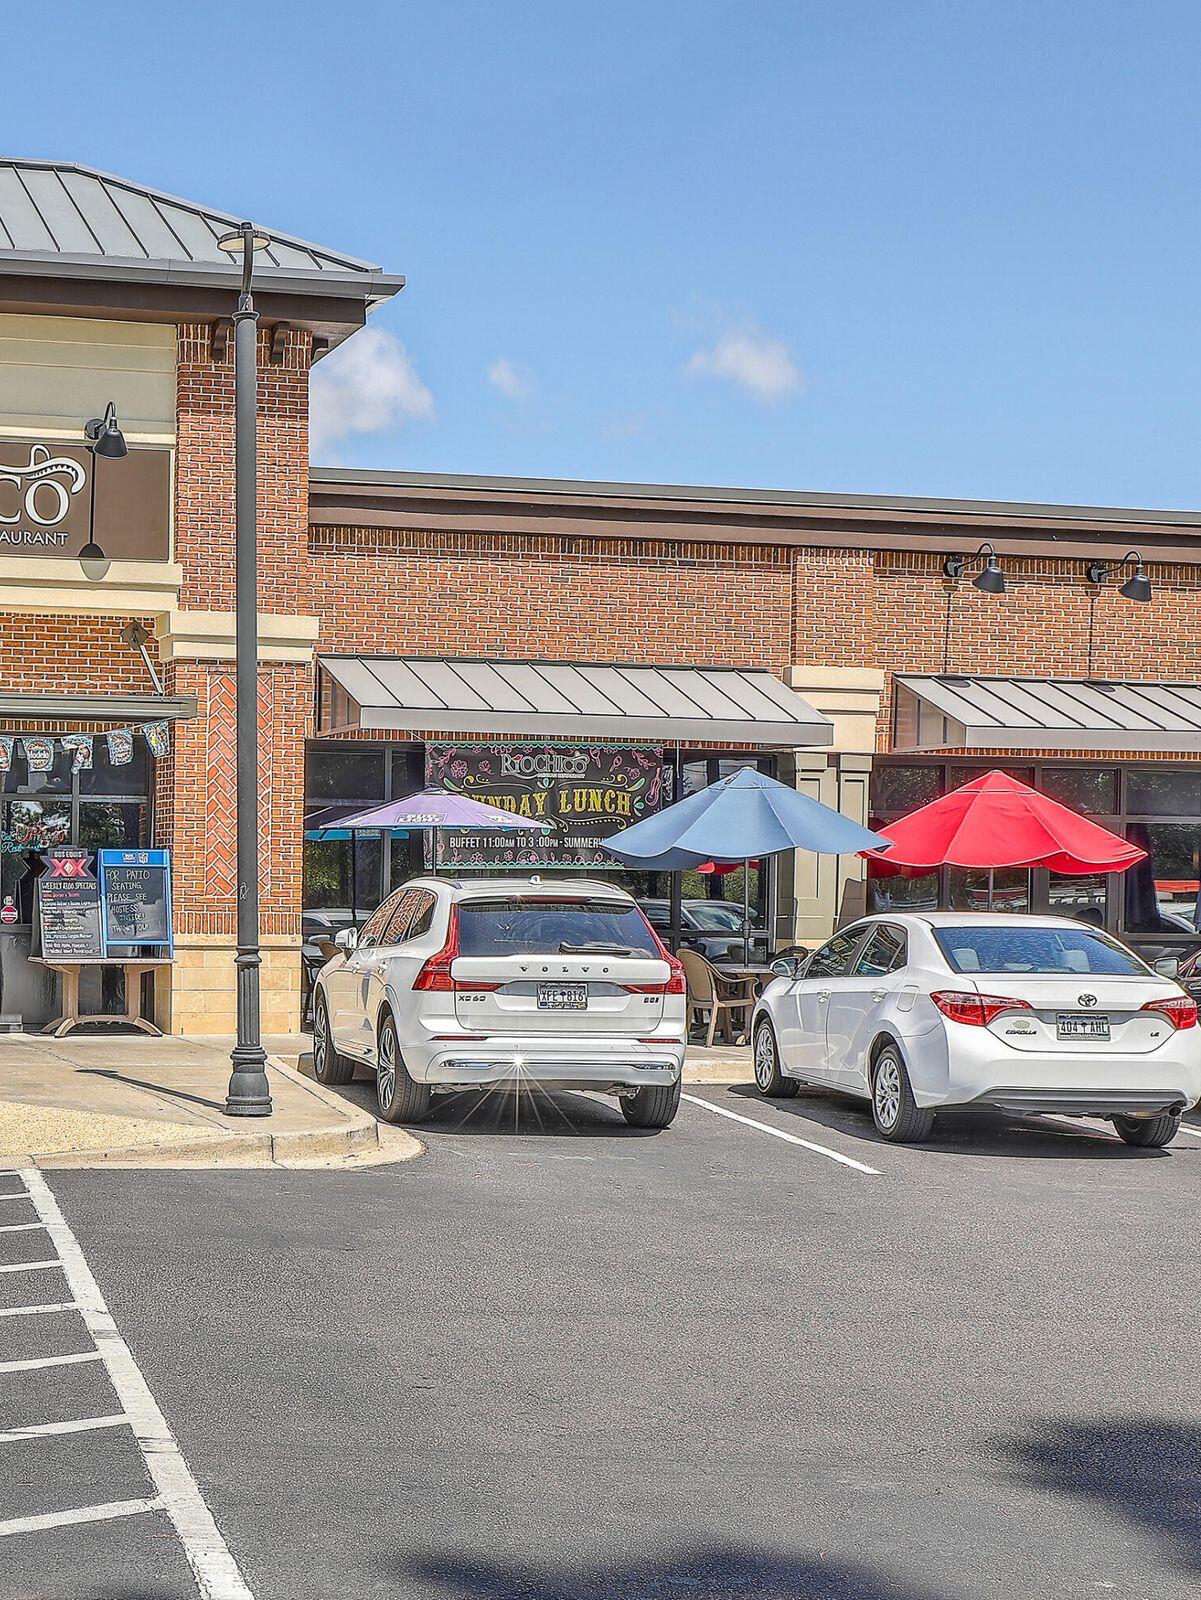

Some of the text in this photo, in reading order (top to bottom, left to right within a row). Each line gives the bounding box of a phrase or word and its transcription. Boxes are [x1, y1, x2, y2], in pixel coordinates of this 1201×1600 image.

[558, 788, 632, 816] LUNCH
[450, 836, 481, 848] BUFFET
[482, 836, 514, 848] 11:00AM
[516, 836, 526, 848] TO
[50, 858, 88, 877] XX
[106, 869, 151, 881] FOR PATIO
[106, 892, 148, 903] PLEASE SEE
[111, 904, 139, 914] HOSTESS
[519, 966, 610, 974] VOLVO
[540, 990, 584, 1001] XFE 816
[1060, 1021, 1107, 1033] 404 AHL
